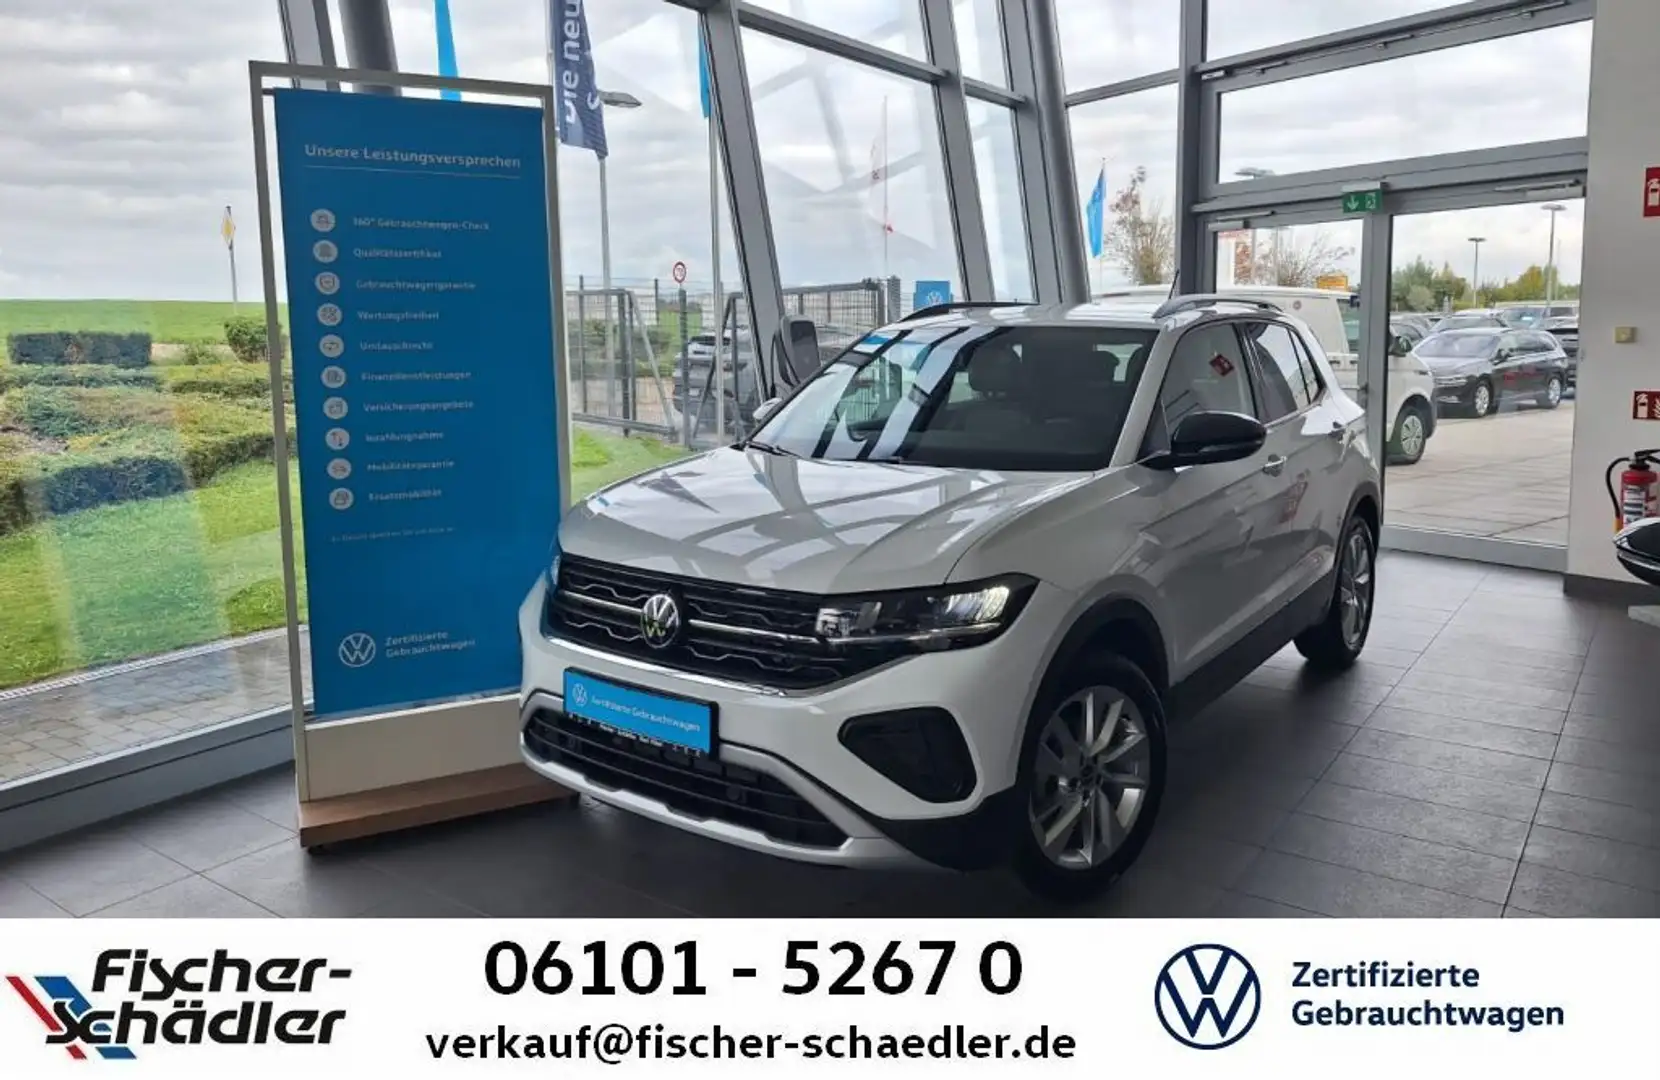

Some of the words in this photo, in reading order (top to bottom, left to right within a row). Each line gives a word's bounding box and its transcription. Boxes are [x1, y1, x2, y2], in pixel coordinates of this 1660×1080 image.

[304, 143, 360, 160] Unsere
[363, 147, 522, 170] Leistungsversprechen
[384, 631, 449, 647] Zertifizierte
[385, 638, 476, 659] Gebrauchtwagen
